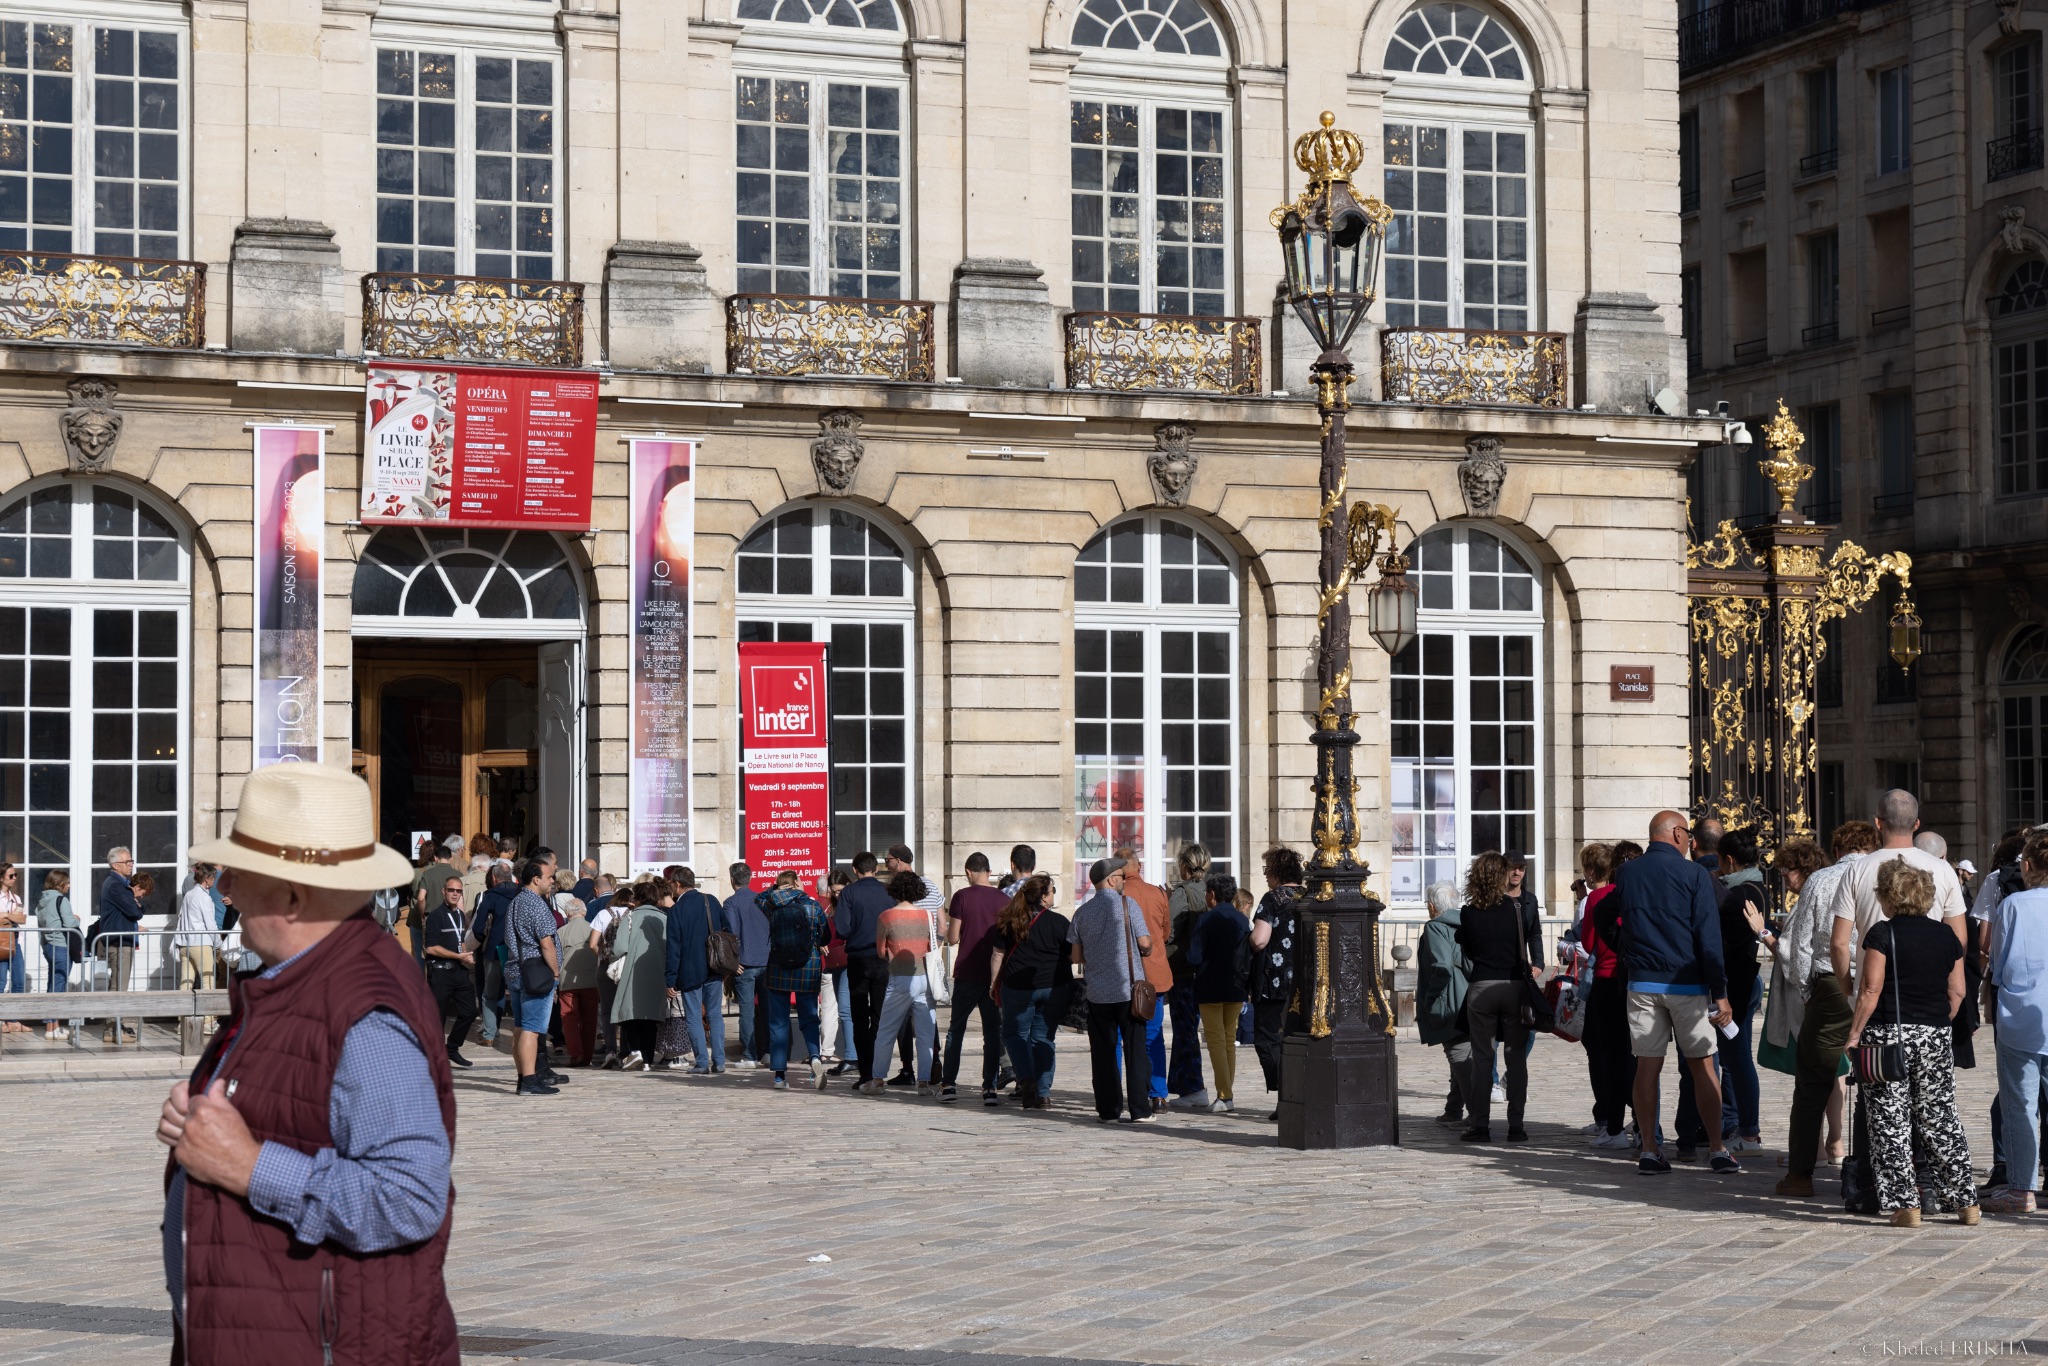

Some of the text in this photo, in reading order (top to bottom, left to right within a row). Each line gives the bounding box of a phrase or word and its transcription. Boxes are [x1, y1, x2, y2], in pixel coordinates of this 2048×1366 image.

[467, 385, 508, 400] OPÉRA
[466, 405, 503, 413] VENDREDI
[414, 416, 424, 425] 44
[528, 430, 565, 438] DIMANCHE
[380, 433, 424, 447] LIVRE
[388, 447, 404, 455] SUR
[378, 455, 424, 469] PLACE
[392, 477, 422, 486] NANCY
[284, 481, 297, 511] 2023
[461, 492, 489, 500] SAMEDI
[284, 522, 297, 551] 2022
[284, 555, 297, 604] SAISON
[644, 634, 679, 642] ORANGES
[642, 654, 651, 662] LE
[643, 661, 653, 669] DE
[1618, 682, 1649, 692] Stanislas
[786, 703, 809, 712] france
[758, 706, 810, 731] inter
[763, 752, 779, 760] Livre
[800, 751, 818, 759] Place
[747, 761, 767, 769] Opéra
[767, 761, 794, 769] National
[804, 761, 825, 769] Nancy
[749, 782, 825, 791] Vendredi 9 septembre
[770, 800, 783, 808] 17h
[788, 800, 801, 808] 18h
[750, 822, 770, 830] C'EST
[771, 821, 799, 830] ENCORE
[800, 820, 820, 829] NOUS
[750, 833, 760, 841] par
[760, 832, 784, 840] Charline
[764, 849, 785, 857] 20h15
[789, 848, 810, 856] 22h15
[762, 859, 813, 868] Enregistrement
[757, 869, 783, 878] MASQU
